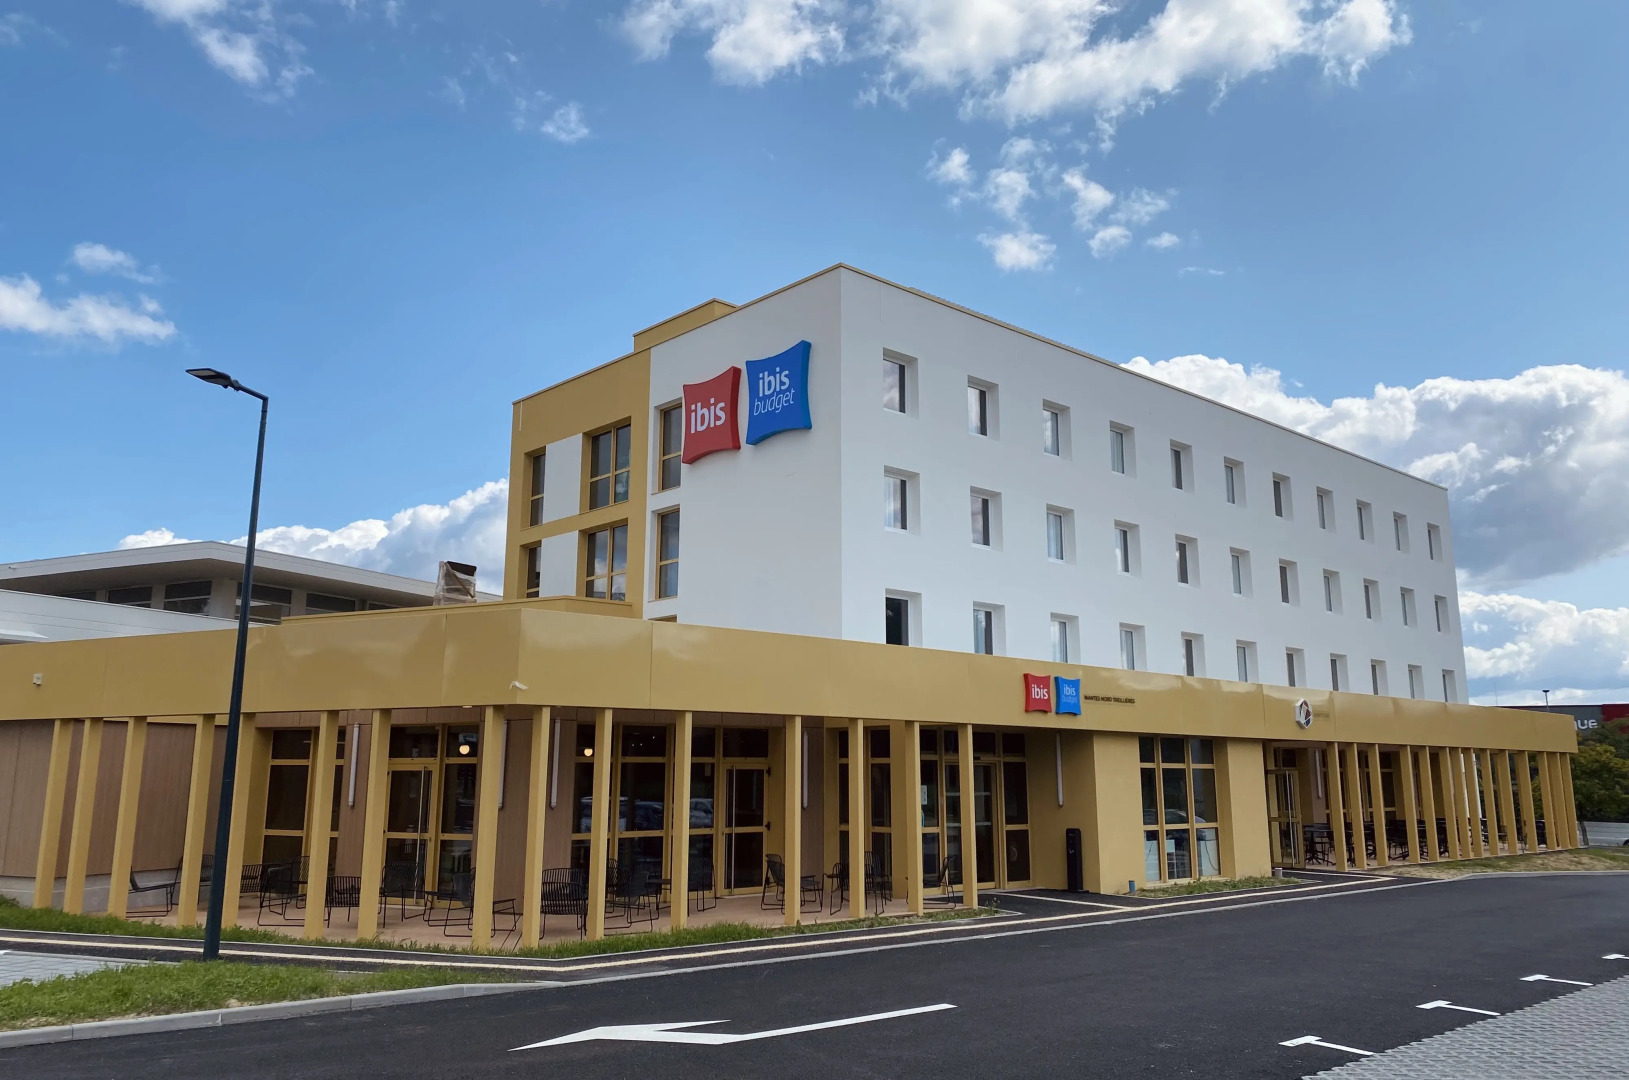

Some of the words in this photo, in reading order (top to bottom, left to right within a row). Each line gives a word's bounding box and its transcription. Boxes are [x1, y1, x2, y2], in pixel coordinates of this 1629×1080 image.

[759, 367, 790, 397] ibis
[690, 397, 726, 434] ibis
[753, 388, 795, 416] budget
[1032, 684, 1048, 699] ibis
[1063, 684, 1076, 696] ibis
